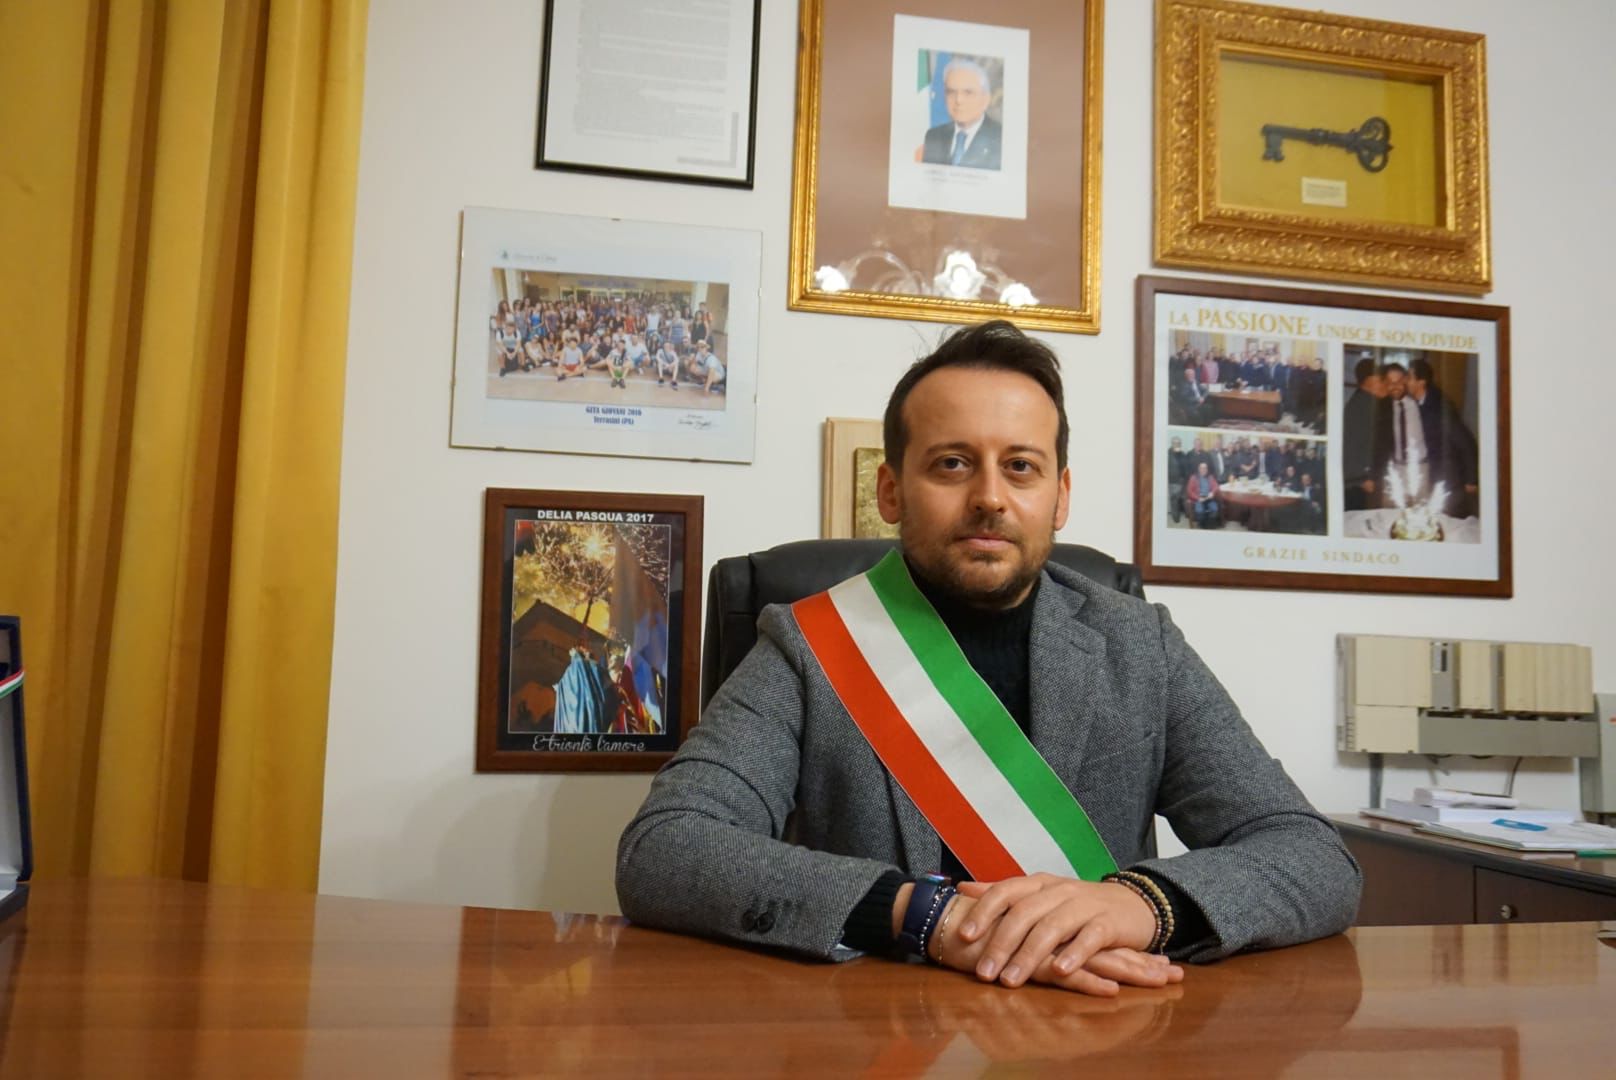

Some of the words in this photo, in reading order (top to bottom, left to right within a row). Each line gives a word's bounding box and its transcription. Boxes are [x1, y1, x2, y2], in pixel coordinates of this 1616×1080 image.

[1168, 310, 1190, 325] LA
[1197, 308, 1311, 336] PASSIONE
[1317, 323, 1376, 341] UNISCE
[1380, 329, 1416, 343] NON
[1421, 332, 1477, 348] DIVIDE
[537, 510, 573, 520] DELIA
[576, 511, 623, 522] PASQUA
[626, 513, 654, 523] 2017
[1243, 547, 1308, 560] GRAZIE
[1322, 551, 1400, 565] SINDACO
